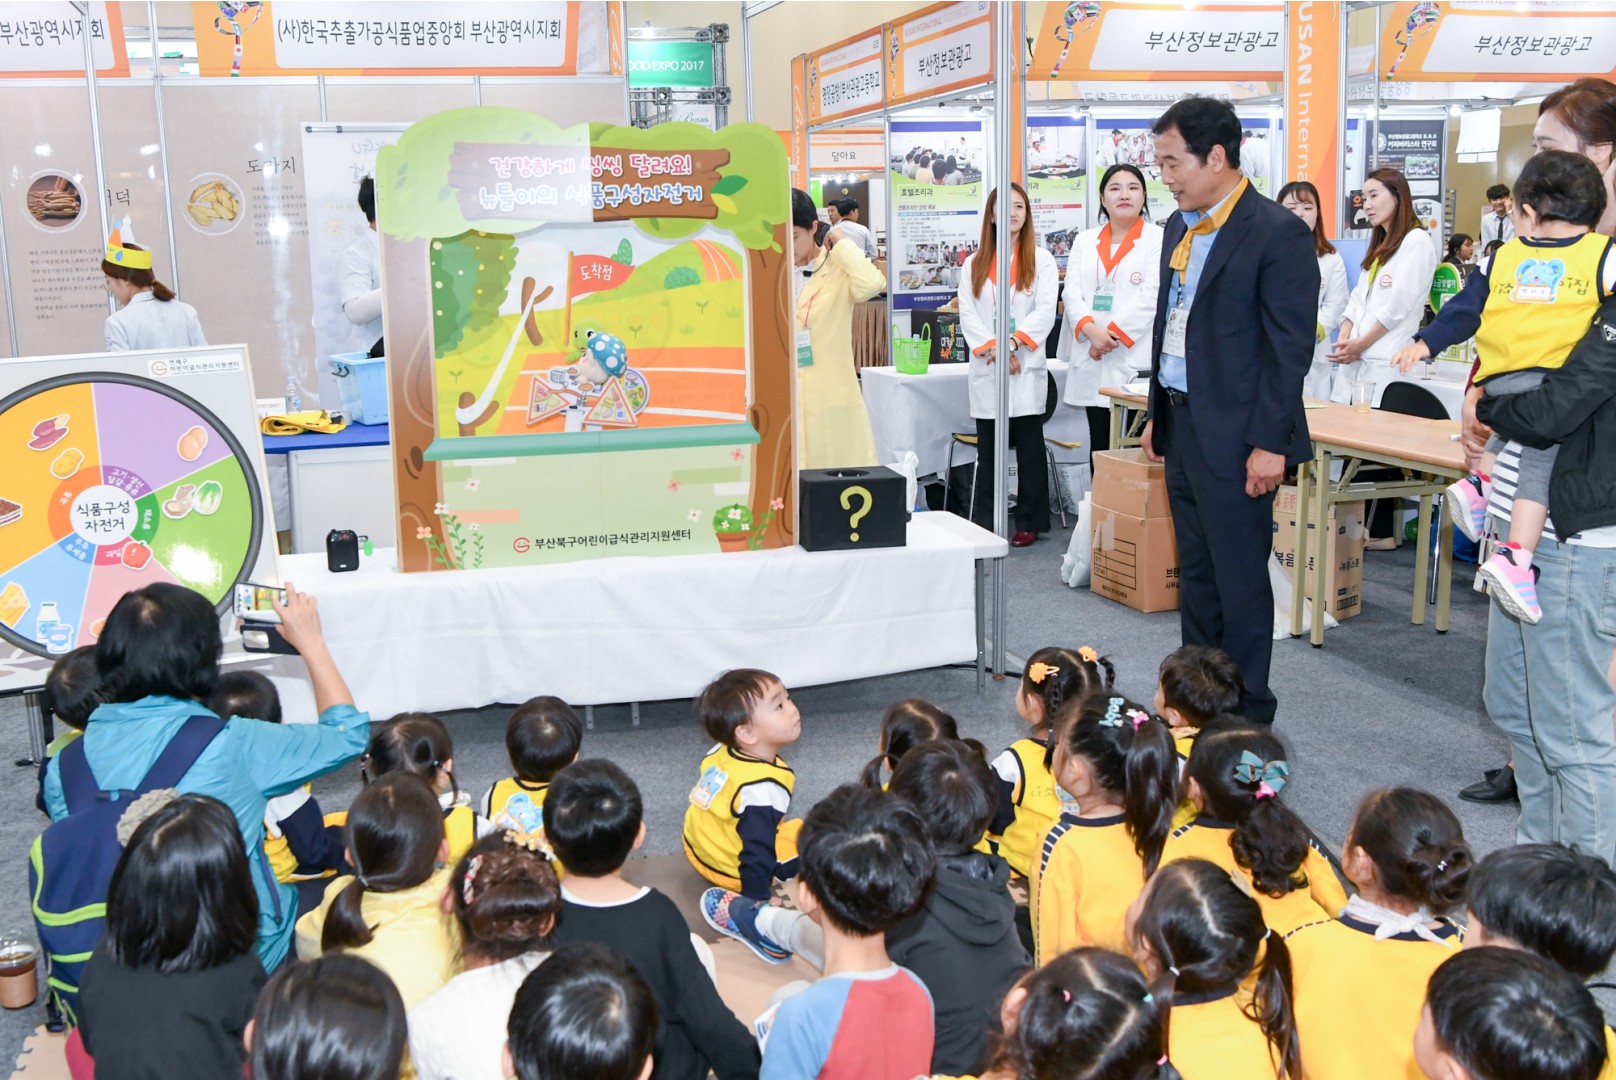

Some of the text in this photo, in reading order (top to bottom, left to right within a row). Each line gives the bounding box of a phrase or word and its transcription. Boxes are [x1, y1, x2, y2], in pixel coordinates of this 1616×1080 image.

[277, 18, 561, 46] (사)한국추출가공식품업중앙회 부산광역시지회
[1145, 31, 1279, 53] 부산정보관광고
[1297, 1, 1313, 96] USAN
[1473, 34, 1593, 56] 부산정보관광고
[628, 60, 705, 72] OOD EXPO 2017
[918, 43, 972, 77] 부산정보관광고
[1421, 140, 1438, 148] 연구회
[489, 154, 693, 178] 건강하게 씽씽 달려요!
[831, 151, 857, 162] 담아요
[479, 182, 703, 211] 뉴틀이의 식품구성자전거
[901, 188, 933, 197] 호텔조리과
[580, 263, 613, 281] 도착점
[170, 361, 240, 372] 어린이급식관리지원센터
[77, 500, 130, 517] 식품구성
[85, 517, 125, 533] 자전거
[534, 528, 692, 551] 부산북구어린이급식관리지원센터
